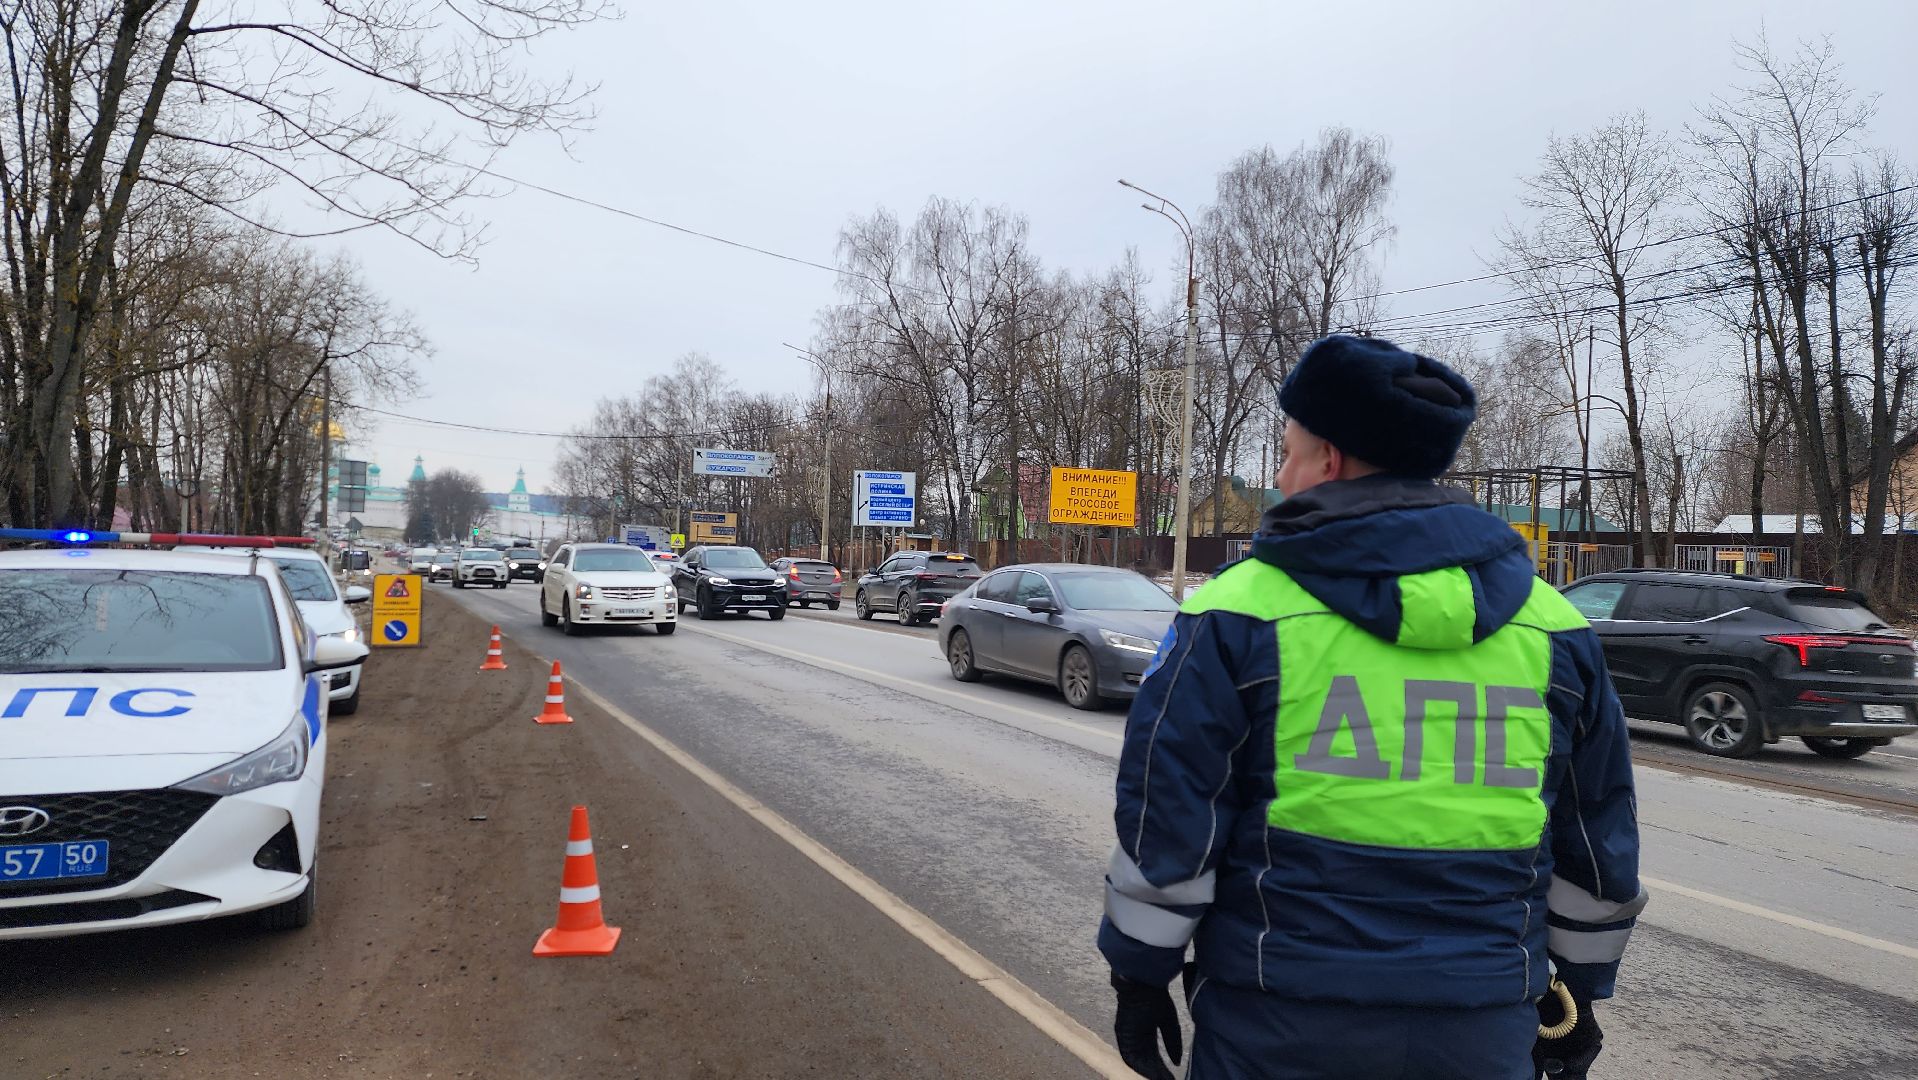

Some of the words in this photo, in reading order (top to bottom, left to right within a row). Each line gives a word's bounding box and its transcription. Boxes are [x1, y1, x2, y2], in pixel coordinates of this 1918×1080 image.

[1062, 472, 1127, 485] ВНИМАНИЕ!!!
[1070, 486, 1117, 499] ВПЕРЕДИ
[1067, 497, 1120, 510] ТРОСОВОЕ
[1052, 508, 1132, 521] ОГРАЖДЕНИЕ!!!
[1294, 675, 1543, 788] ДПС
[3, 848, 44, 876] 57
[65, 844, 97, 865] 50
[69, 864, 92, 873] RUS
